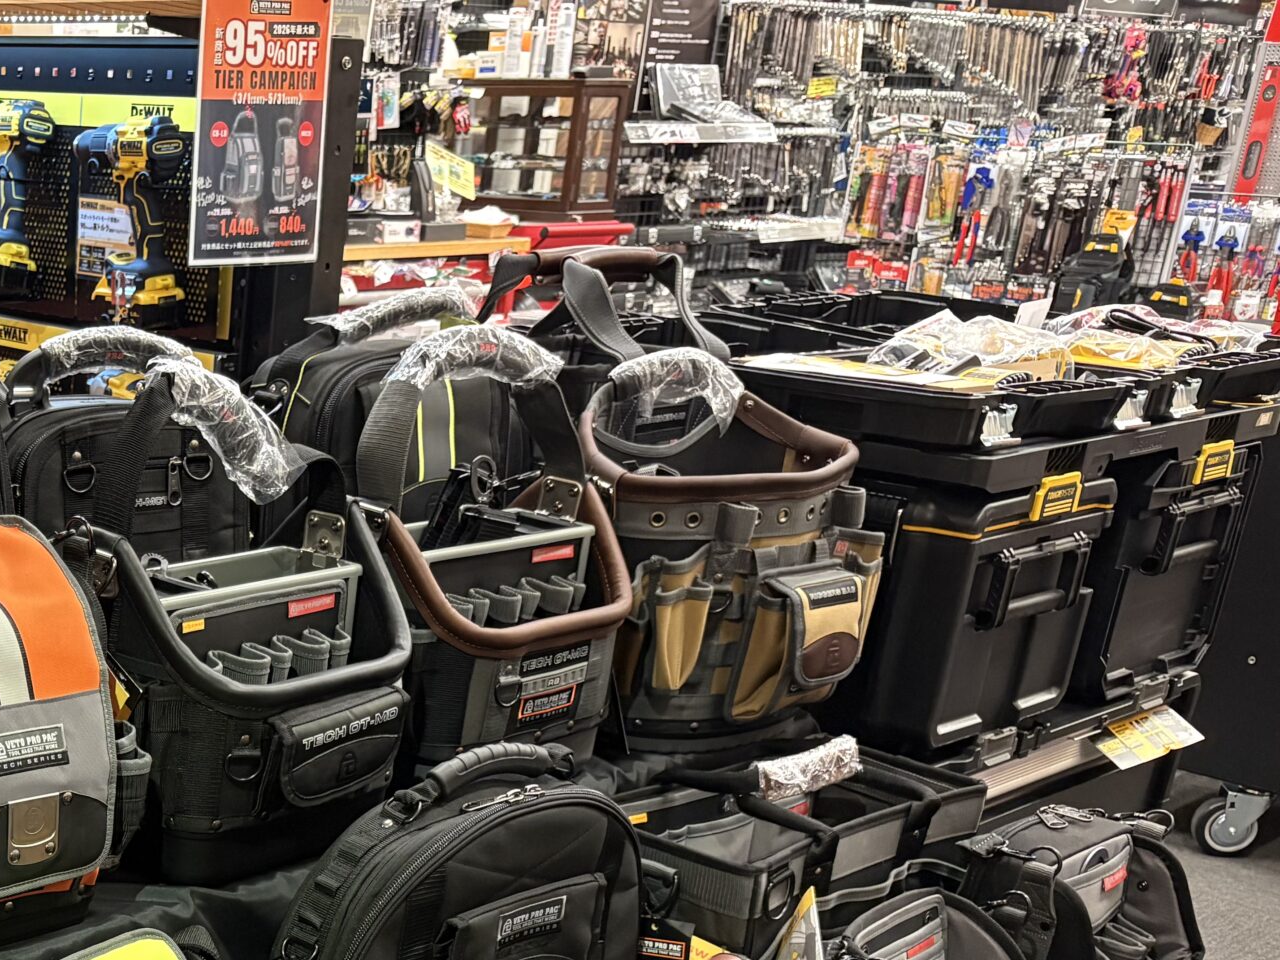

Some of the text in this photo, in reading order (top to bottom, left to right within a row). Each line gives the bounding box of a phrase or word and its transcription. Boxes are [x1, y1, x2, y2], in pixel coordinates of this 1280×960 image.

[214, 70, 317, 90] TIER CAMPAIGN
[522, 655, 553, 672] TECH
[302, 706, 398, 750] TECH OT-MD
[5, 738, 25, 749] VETO
[26, 734, 41, 745] PRO
[27, 754, 63, 764] SERIES
[513, 913, 530, 924] VETO
[530, 909, 544, 919] PRO
[654, 941, 682, 951] PRO PAC
